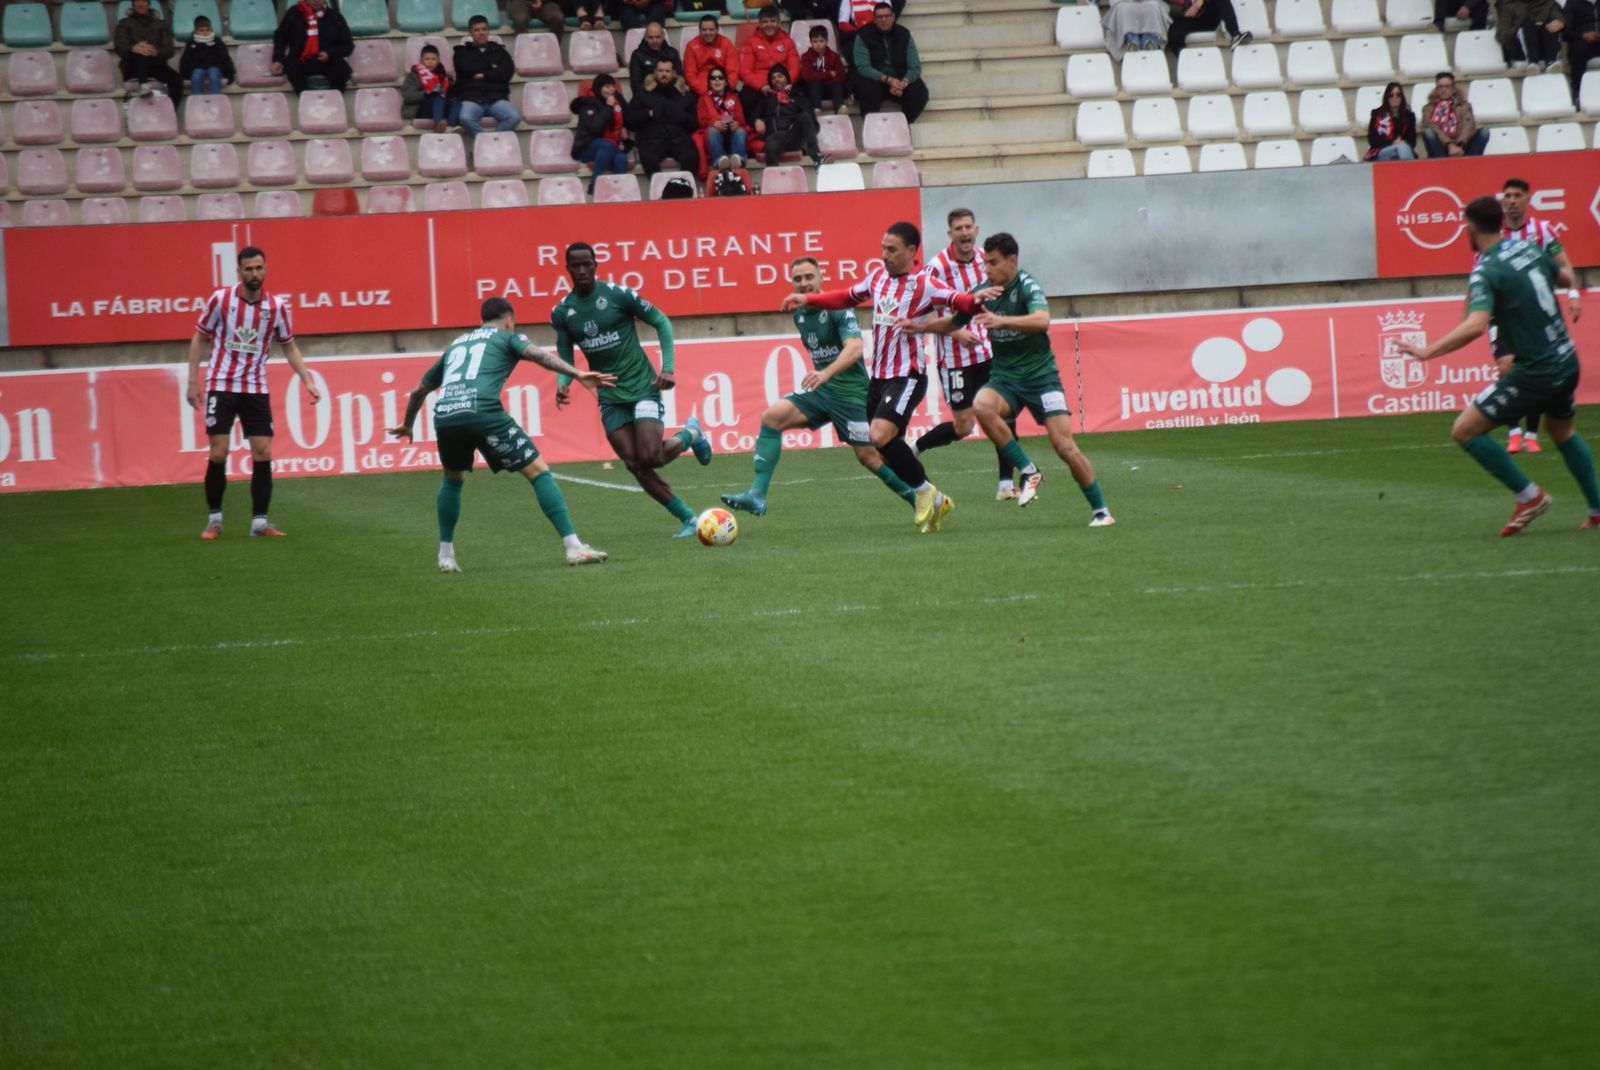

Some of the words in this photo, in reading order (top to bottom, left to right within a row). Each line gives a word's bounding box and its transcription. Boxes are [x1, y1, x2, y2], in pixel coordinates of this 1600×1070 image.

[537, 231, 823, 266] RSTAURANTE
[476, 271, 644, 300] PALAO
[664, 267, 738, 290] DEL
[51, 301, 82, 318] LA
[94, 295, 206, 316] FÁBRICA
[300, 292, 333, 309] LA
[341, 290, 391, 307] LUZ
[441, 342, 487, 387] 21
[1120, 378, 1263, 420] juventud
[1367, 390, 1456, 415] Castilla
[1145, 414, 1204, 430] castilla
[1224, 411, 1260, 424] león
[721, 430, 813, 451] Coeo
[240, 453, 335, 475] Crreo
[361, 448, 393, 469] de
